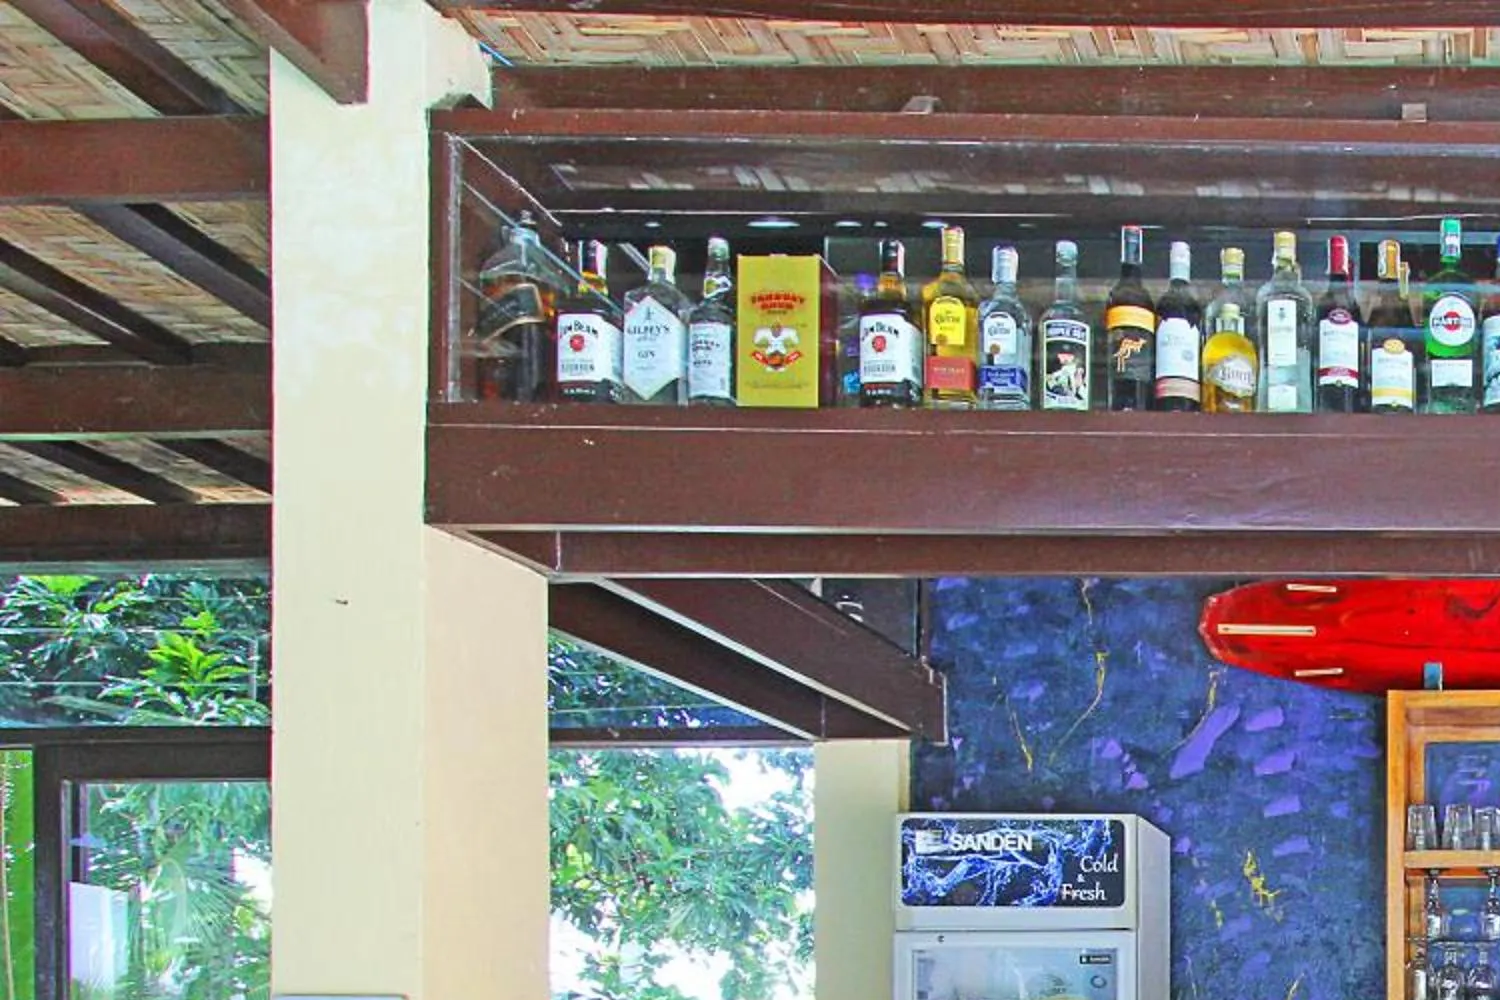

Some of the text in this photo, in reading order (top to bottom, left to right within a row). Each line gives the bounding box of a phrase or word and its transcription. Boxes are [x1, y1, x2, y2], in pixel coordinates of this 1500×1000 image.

[950, 832, 1033, 852] SANDEN
[1079, 855, 1119, 874] Cold
[1061, 883, 1106, 901] Fresh
